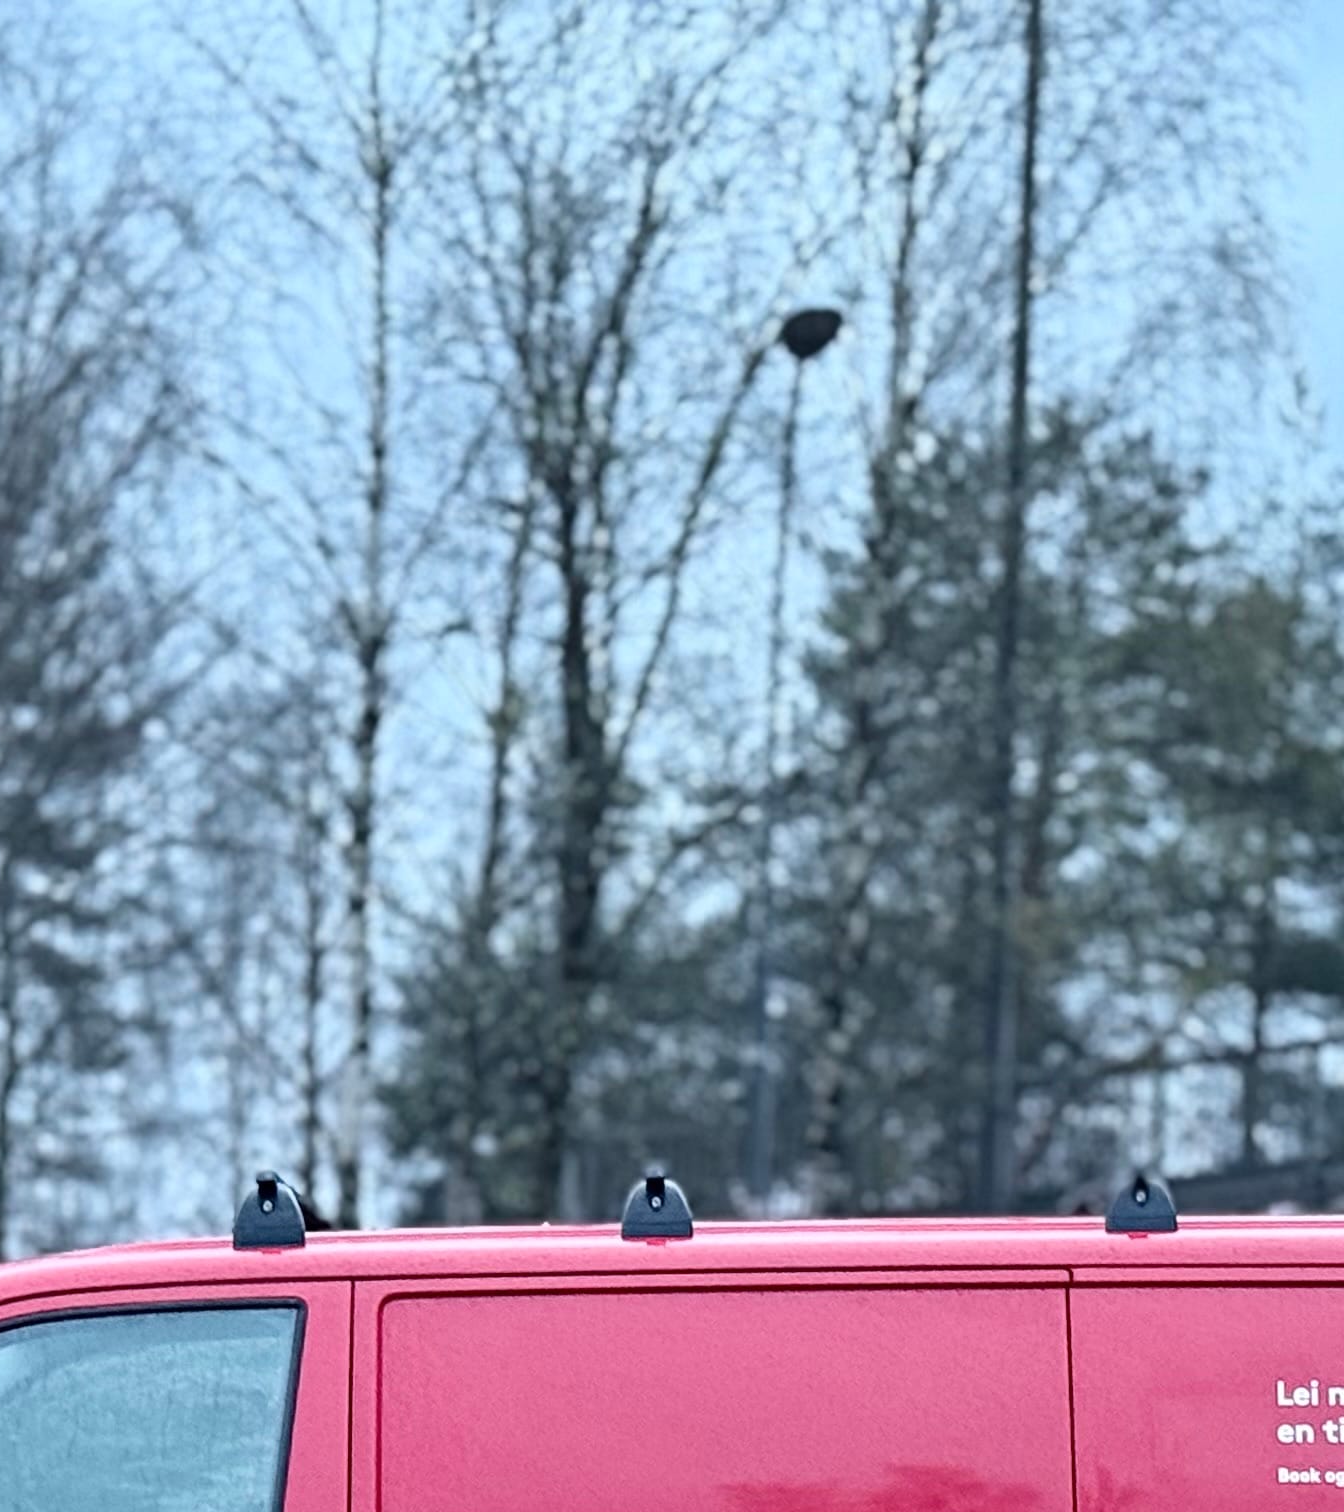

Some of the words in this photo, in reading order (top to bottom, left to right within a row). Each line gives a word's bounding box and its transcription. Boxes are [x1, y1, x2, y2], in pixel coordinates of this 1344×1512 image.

[1276, 1379, 1319, 1407] Lei
[1276, 1423, 1315, 1444] en
[1277, 1467, 1322, 1484] Book
